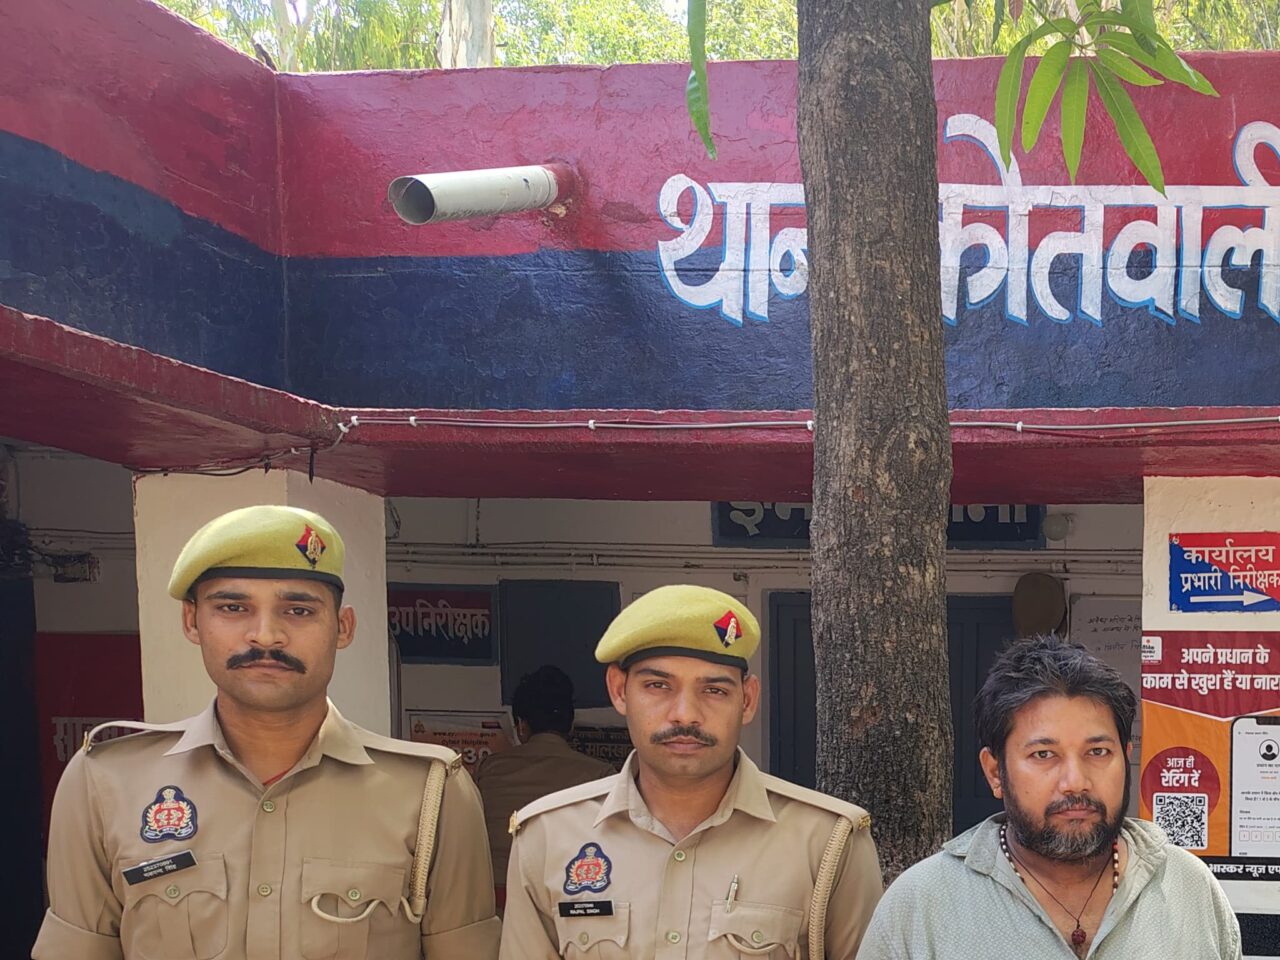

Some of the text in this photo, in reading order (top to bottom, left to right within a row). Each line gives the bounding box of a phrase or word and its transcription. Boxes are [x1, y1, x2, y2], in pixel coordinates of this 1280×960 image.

[1182, 538, 1277, 564] कार्यालय
[1180, 563, 1280, 593] प्रभारी निरीक्षक
[1181, 643, 1215, 665] अपने
[1216, 648, 1254, 665] प्रधान
[1255, 643, 1270, 665] के
[1141, 672, 1173, 690] काम
[1174, 668, 1189, 690] से
[1190, 673, 1222, 695] खुश
[1222, 669, 1235, 690] हैं
[1236, 674, 1252, 690] या
[1166, 755, 1195, 768] आज ही
[1160, 768, 1201, 788] रेटिंग दें
[1245, 864, 1266, 877] न्यूज
